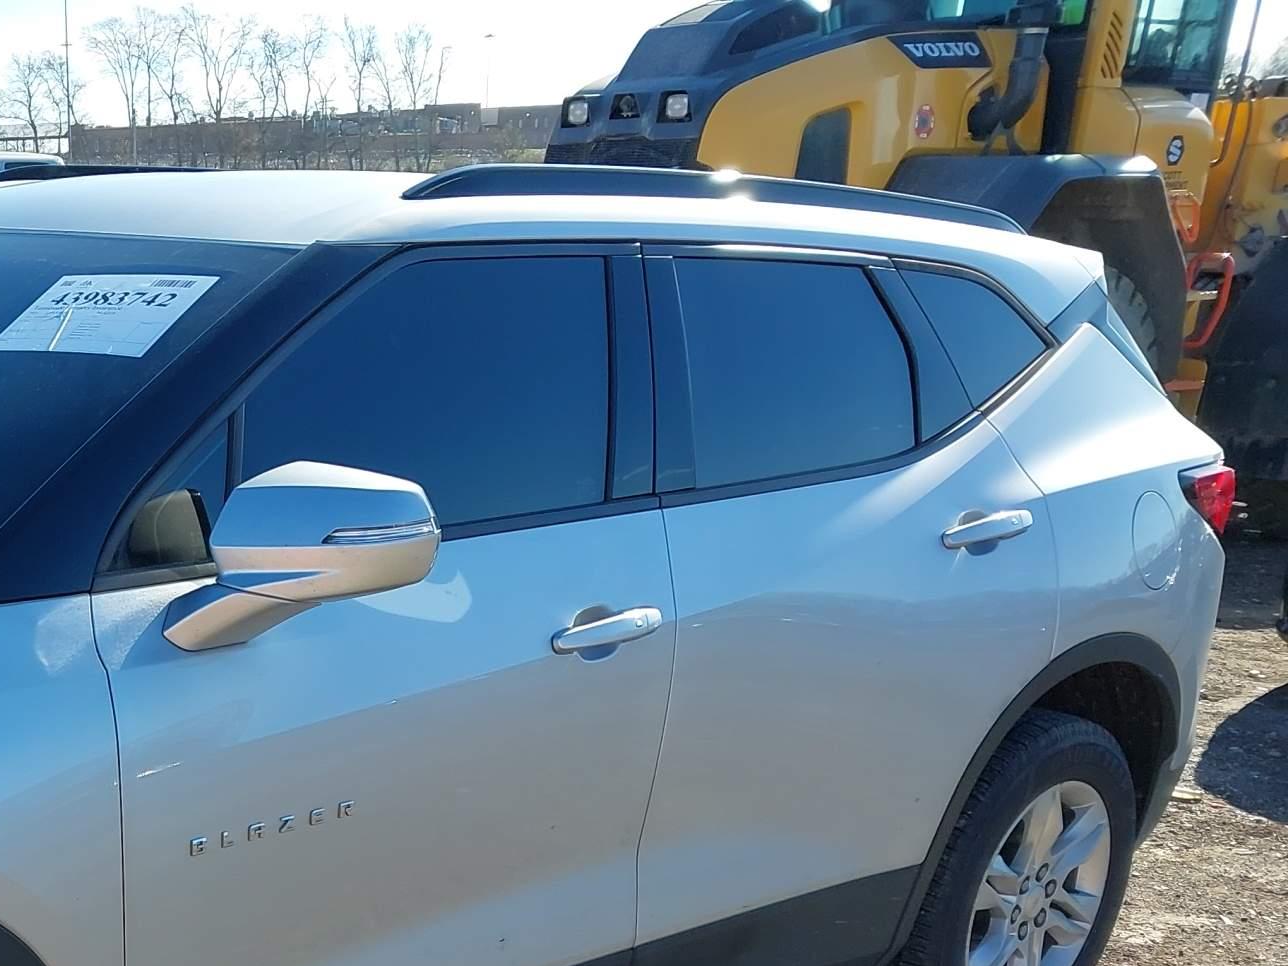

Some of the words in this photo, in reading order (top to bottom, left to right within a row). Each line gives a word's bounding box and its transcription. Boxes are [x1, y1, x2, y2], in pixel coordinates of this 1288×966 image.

[903, 42, 980, 57] VOLVO
[50, 291, 178, 307] 43983742
[189, 800, 355, 857] BLAZER
